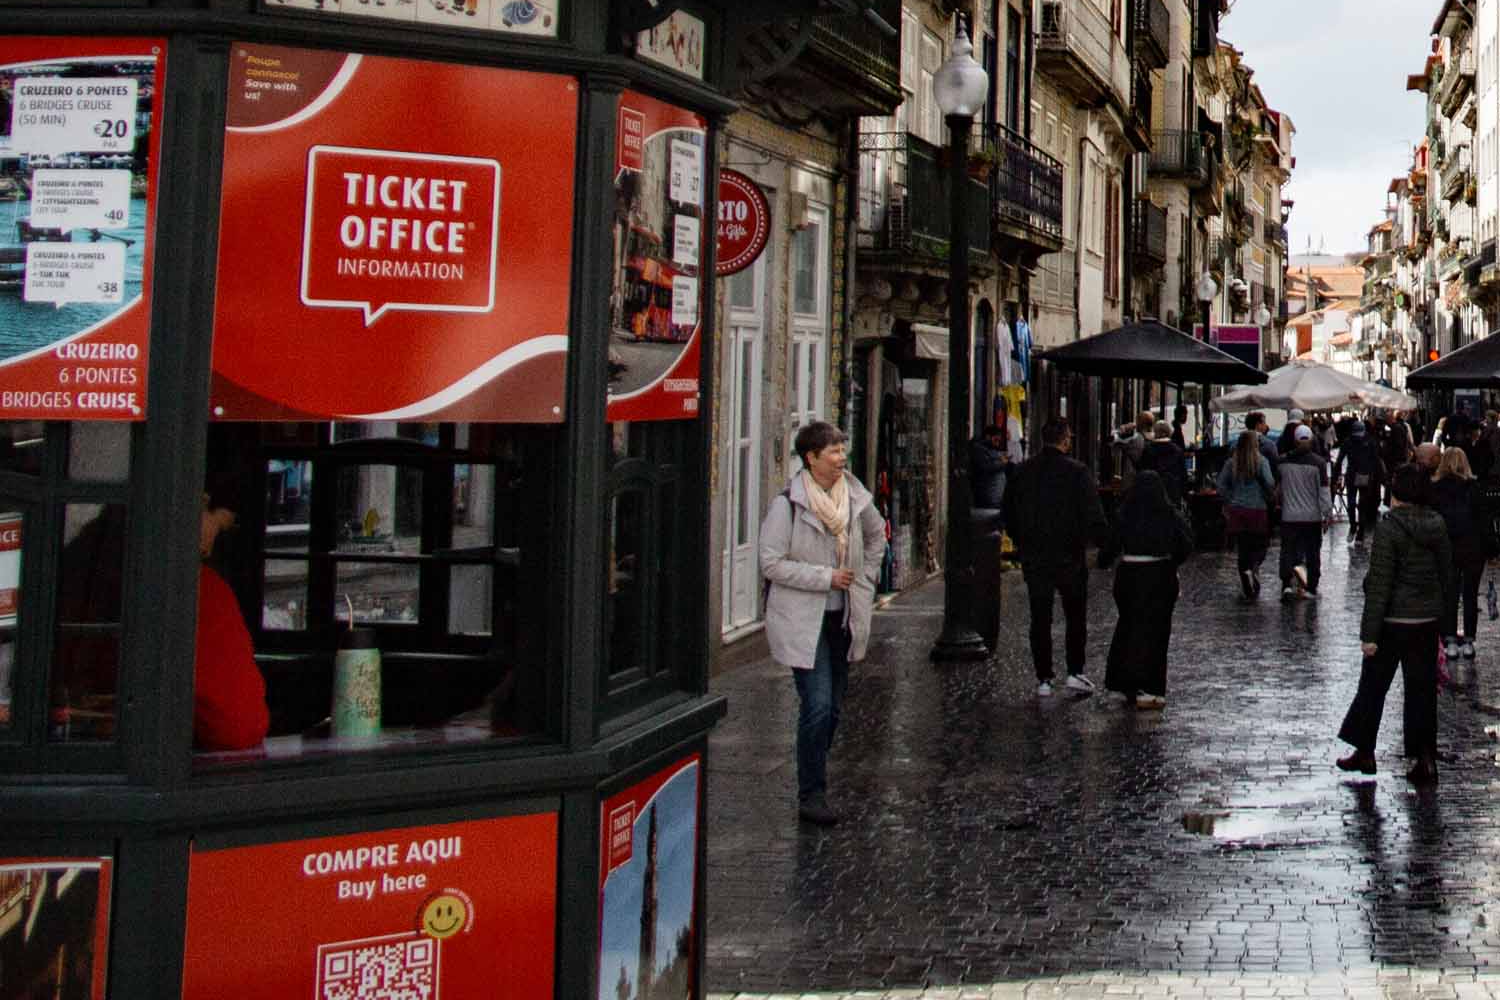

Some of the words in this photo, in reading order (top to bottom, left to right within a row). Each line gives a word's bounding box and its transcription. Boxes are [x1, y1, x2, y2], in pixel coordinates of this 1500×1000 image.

[20, 86, 73, 96] CRUZEIRO
[76, 86, 83, 96] 6
[87, 86, 128, 96] PONTES
[245, 79, 272, 89] Save
[273, 82, 297, 91] with
[244, 91, 261, 101] us!
[29, 100, 73, 111] BRIDGES
[77, 100, 113, 110] CRUISE
[19, 114, 38, 126] (50
[40, 114, 67, 126] MIN)
[94, 119, 128, 138] €20
[343, 172, 468, 213] TICKET
[339, 214, 466, 254] OFFICE
[337, 258, 464, 280] INFORMATION
[56, 343, 138, 360] CRUZEIRO
[59, 367, 69, 383] 6
[75, 367, 137, 384] PONTES
[1, 391, 71, 408] BRIDGES
[77, 392, 137, 409] CRUISE
[303, 843, 399, 876] COMPRE
[406, 836, 462, 865] AQUI
[337, 878, 376, 900] Buy
[381, 872, 427, 895] here
